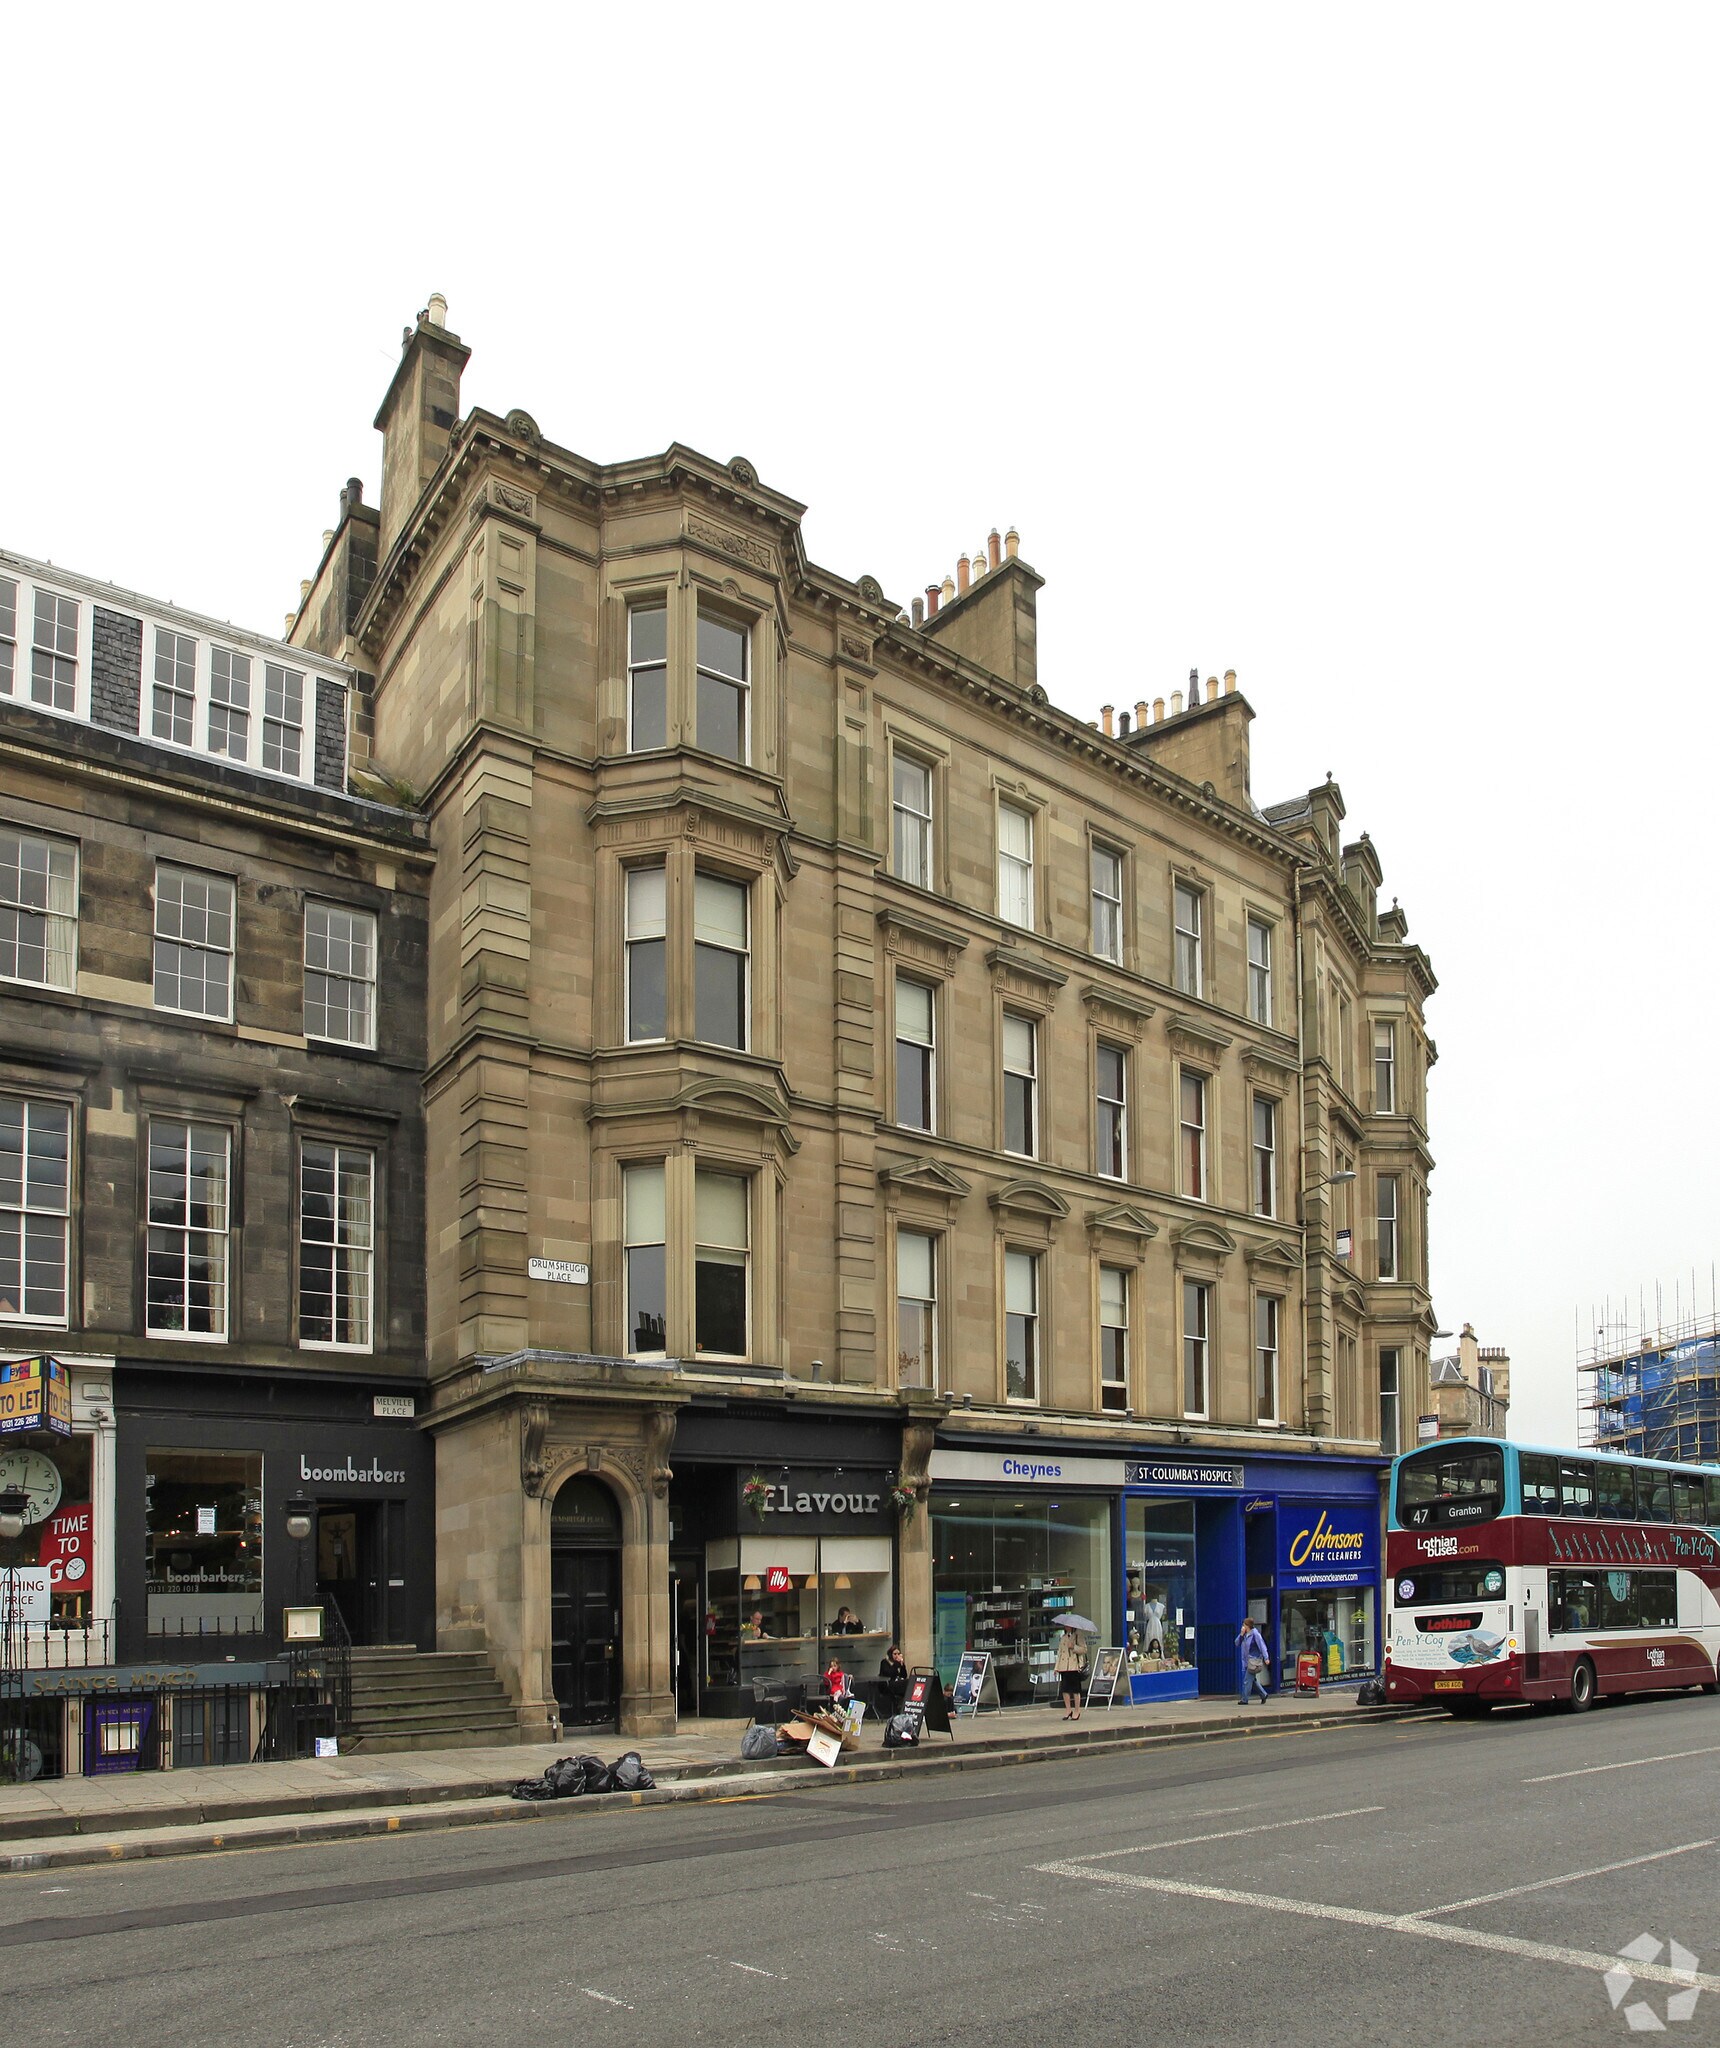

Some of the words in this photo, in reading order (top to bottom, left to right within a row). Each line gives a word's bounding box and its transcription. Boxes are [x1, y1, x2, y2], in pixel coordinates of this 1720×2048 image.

[531, 1259, 586, 1274] DRUMSHEUGH
[547, 1271, 571, 1282] PLACE
[0, 1394, 14, 1414] TO
[20, 1389, 40, 1411] LET
[49, 1391, 58, 1412] TO
[376, 1398, 412, 1407] MELVILLE
[382, 1407, 407, 1416] PLACE
[301, 1454, 406, 1483] boombarbers
[1003, 1459, 1062, 1479] Cheynes
[1200, 1470, 1233, 1482] HOSPICE
[762, 1484, 880, 1514] flavour
[1413, 1508, 1429, 1524] 47
[1448, 1506, 1482, 1518] Granton
[51, 1514, 89, 1535] TIME
[58, 1536, 80, 1555] TO
[1289, 1510, 1364, 1567] Johnsons
[1417, 1535, 1458, 1550] Lothian
[1311, 1551, 1324, 1561] THE
[1327, 1550, 1362, 1561] CLEANERS
[1675, 1536, 1714, 1564] Pen-Y-Cog
[166, 1565, 245, 1583] boombarbers
[770, 1570, 787, 1589] illy
[1296, 1572, 1359, 1585] www.johnsoncleaners.com
[1616, 1572, 1624, 1586] 37
[148, 1585, 165, 1593] 0131
[167, 1585, 181, 1593] 220
[182, 1585, 199, 1593] 1013
[1616, 1588, 1624, 1601] 47
[5, 1595, 34, 1605] PRCE
[1427, 1618, 1472, 1631] Lothian
[1396, 1633, 1444, 1648] Pen-Y-Cog
[1646, 1648, 1664, 1660] Lothian
